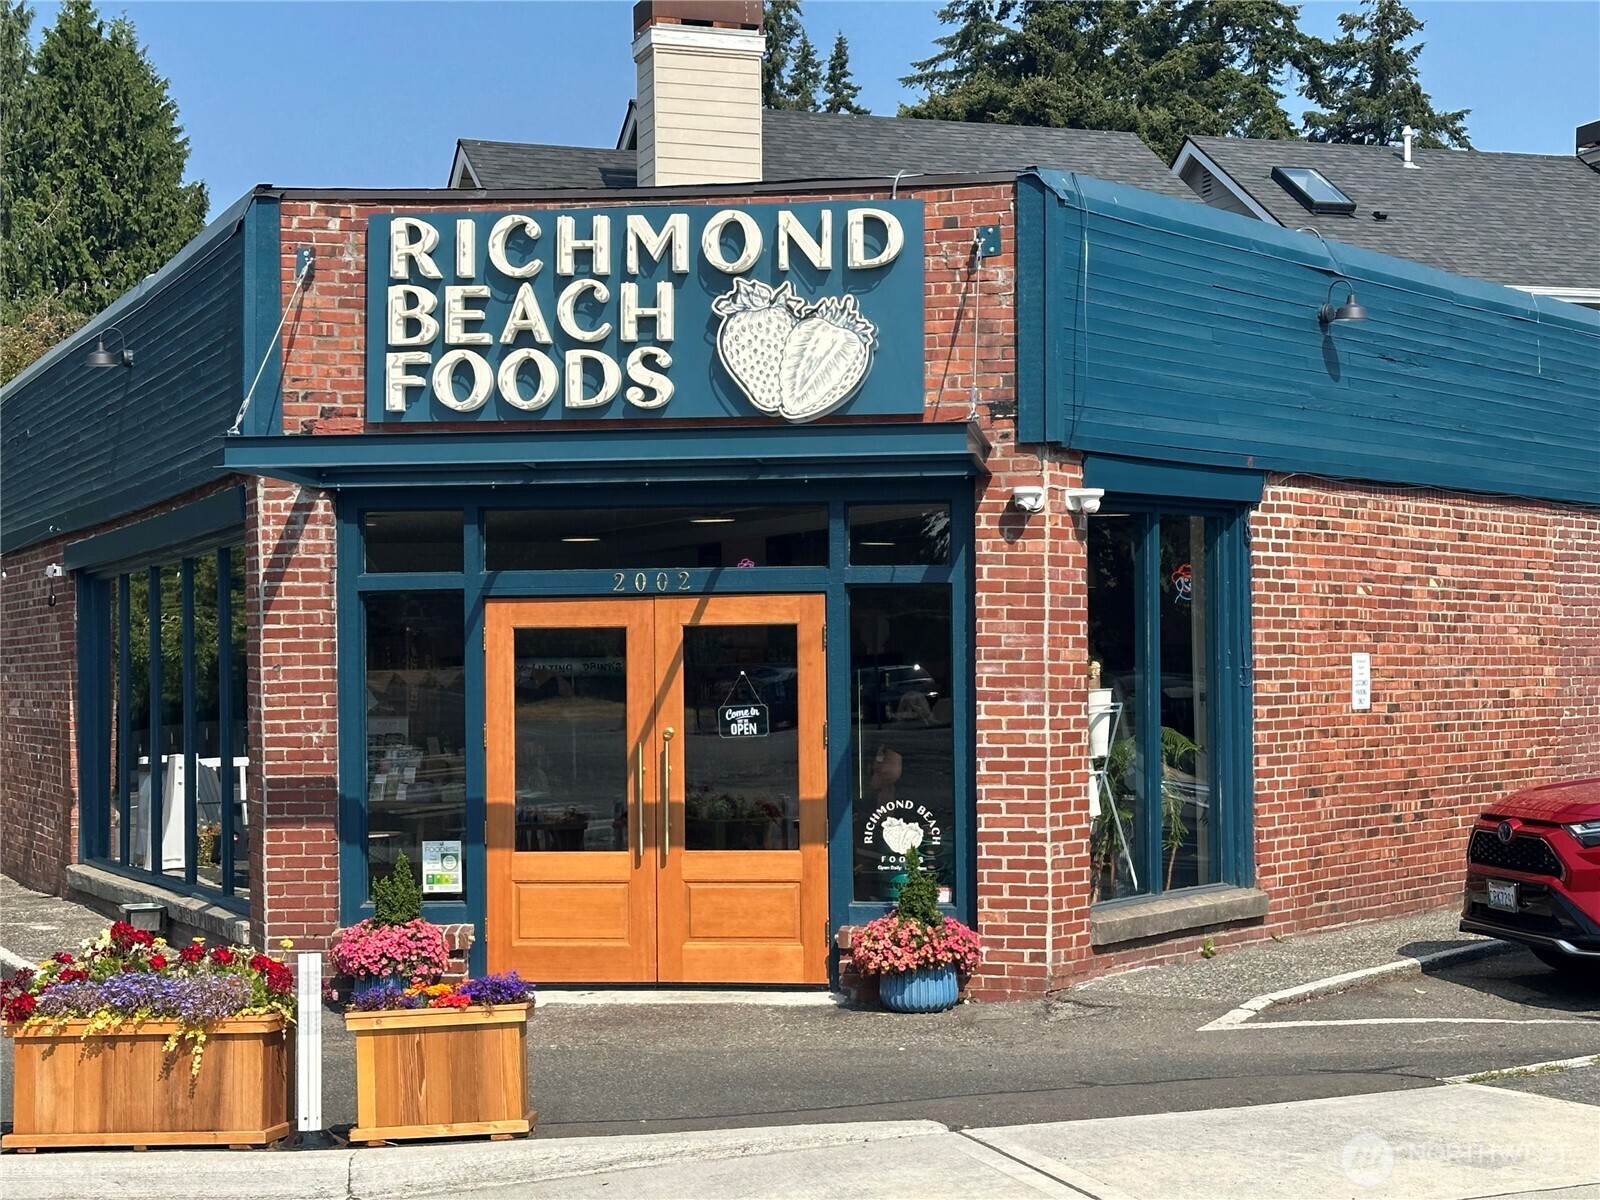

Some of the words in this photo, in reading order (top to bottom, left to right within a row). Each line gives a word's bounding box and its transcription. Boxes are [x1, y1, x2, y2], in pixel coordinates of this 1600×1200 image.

[389, 207, 904, 280] RICHMOND
[387, 278, 675, 346] BEACH
[385, 347, 675, 413] FOODS
[612, 571, 691, 592] 2002
[582, 662, 622, 673] DRINKS
[725, 708, 750, 721] Come
[730, 722, 757, 736] OPEN
[864, 800, 914, 844] RICHMOND
[916, 805, 941, 846] BEACH
[881, 855, 924, 863] FOOS
